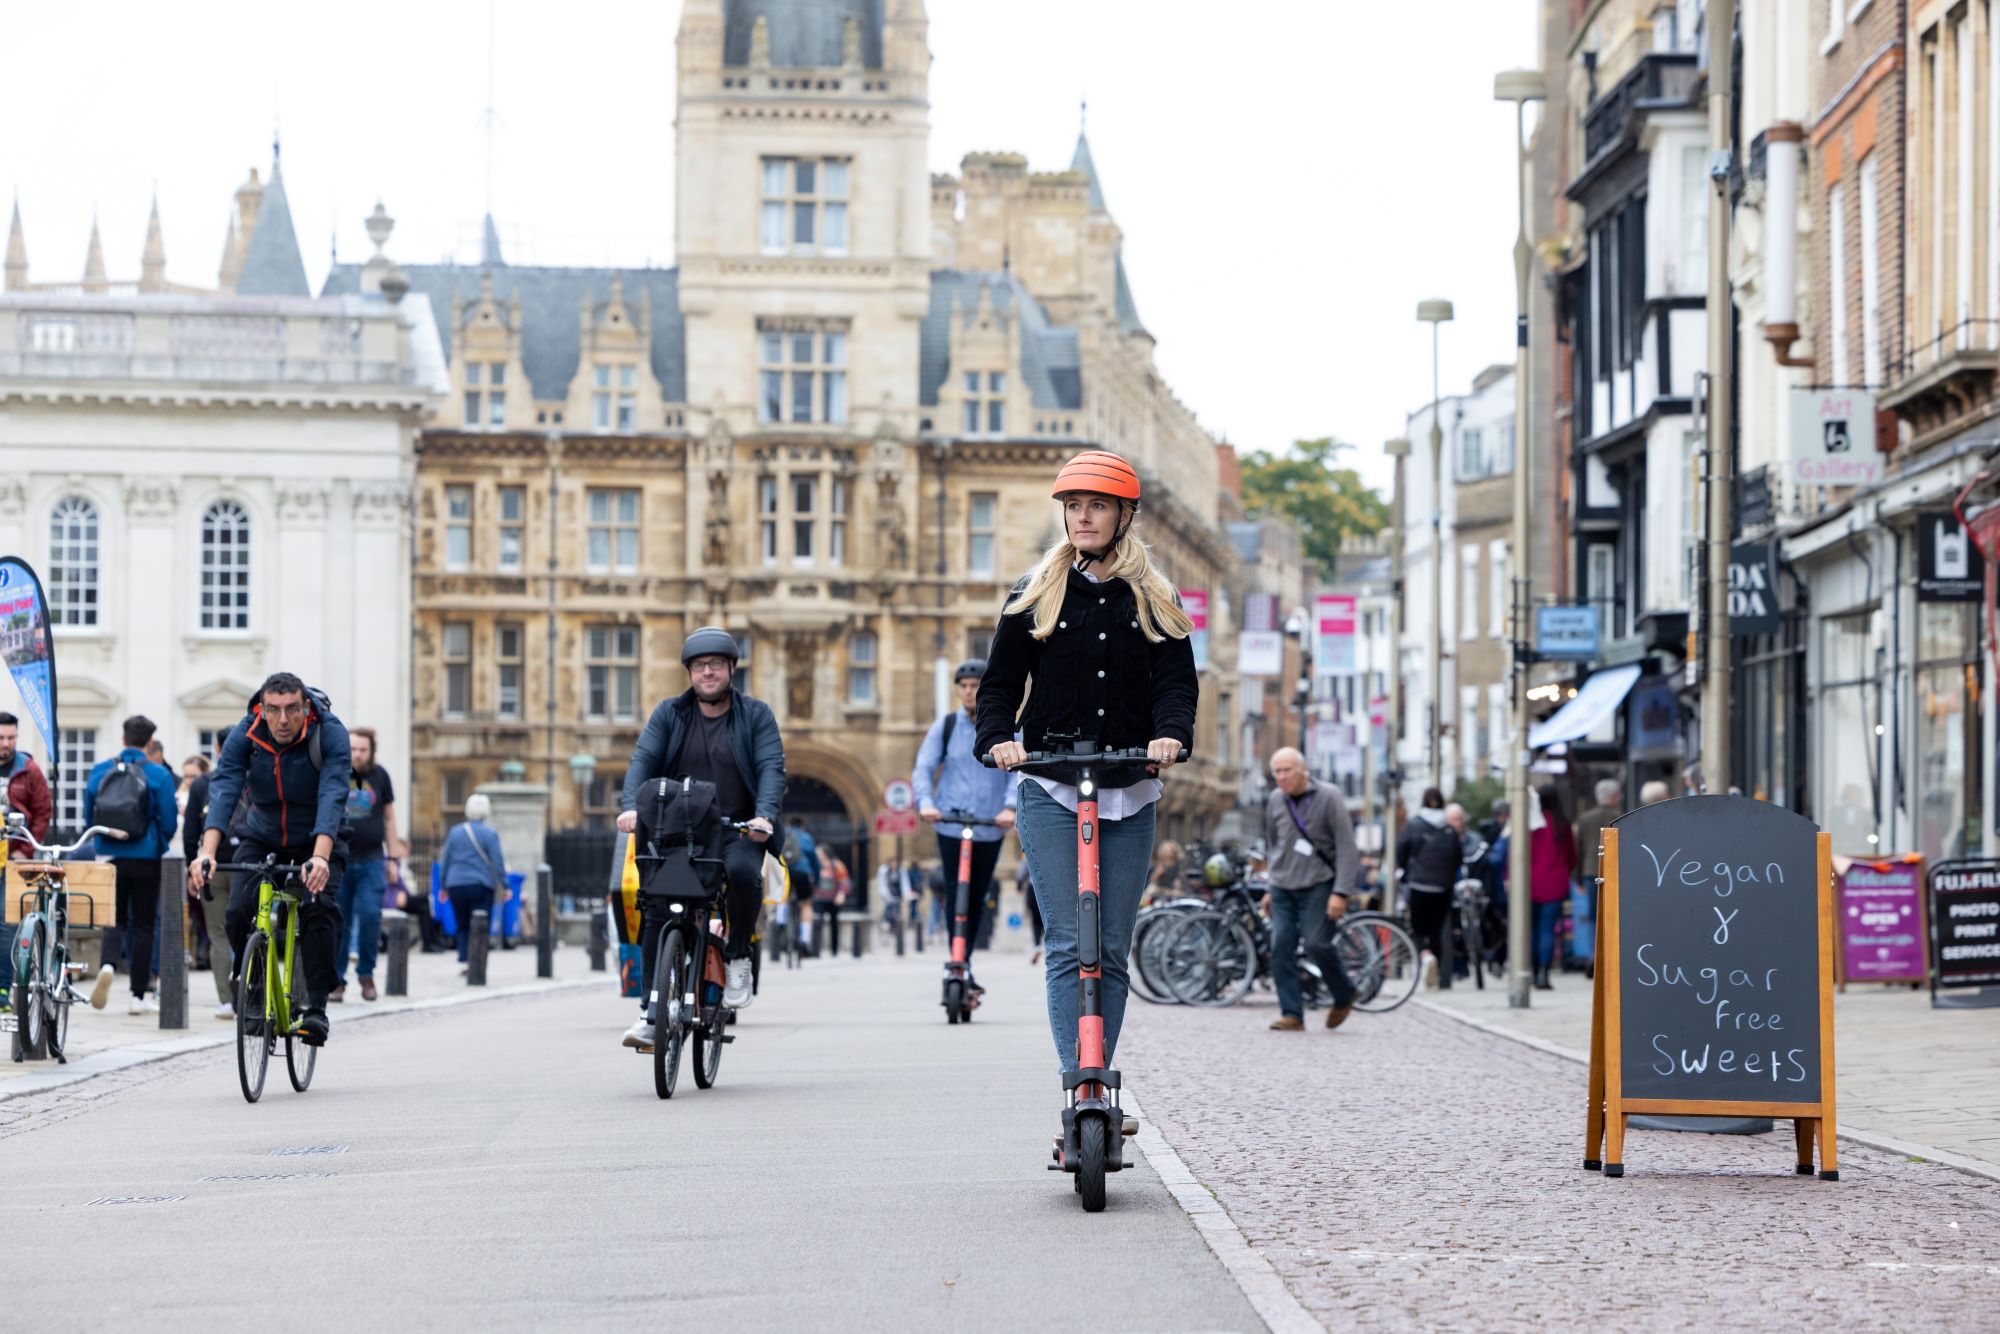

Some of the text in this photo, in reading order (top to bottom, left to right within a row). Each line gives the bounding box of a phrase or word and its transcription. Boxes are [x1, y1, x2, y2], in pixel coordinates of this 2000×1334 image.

[1820, 396, 1853, 418] Art
[1797, 456, 1878, 481] Gallery
[1640, 844, 1784, 897] Vegan
[1861, 912, 1900, 926] OPEN
[1949, 902, 2000, 919] PHOTO
[1954, 923, 1998, 939] PRINT
[1637, 943, 1780, 1005] Sugar
[1652, 1034, 1806, 1082] Sweets
